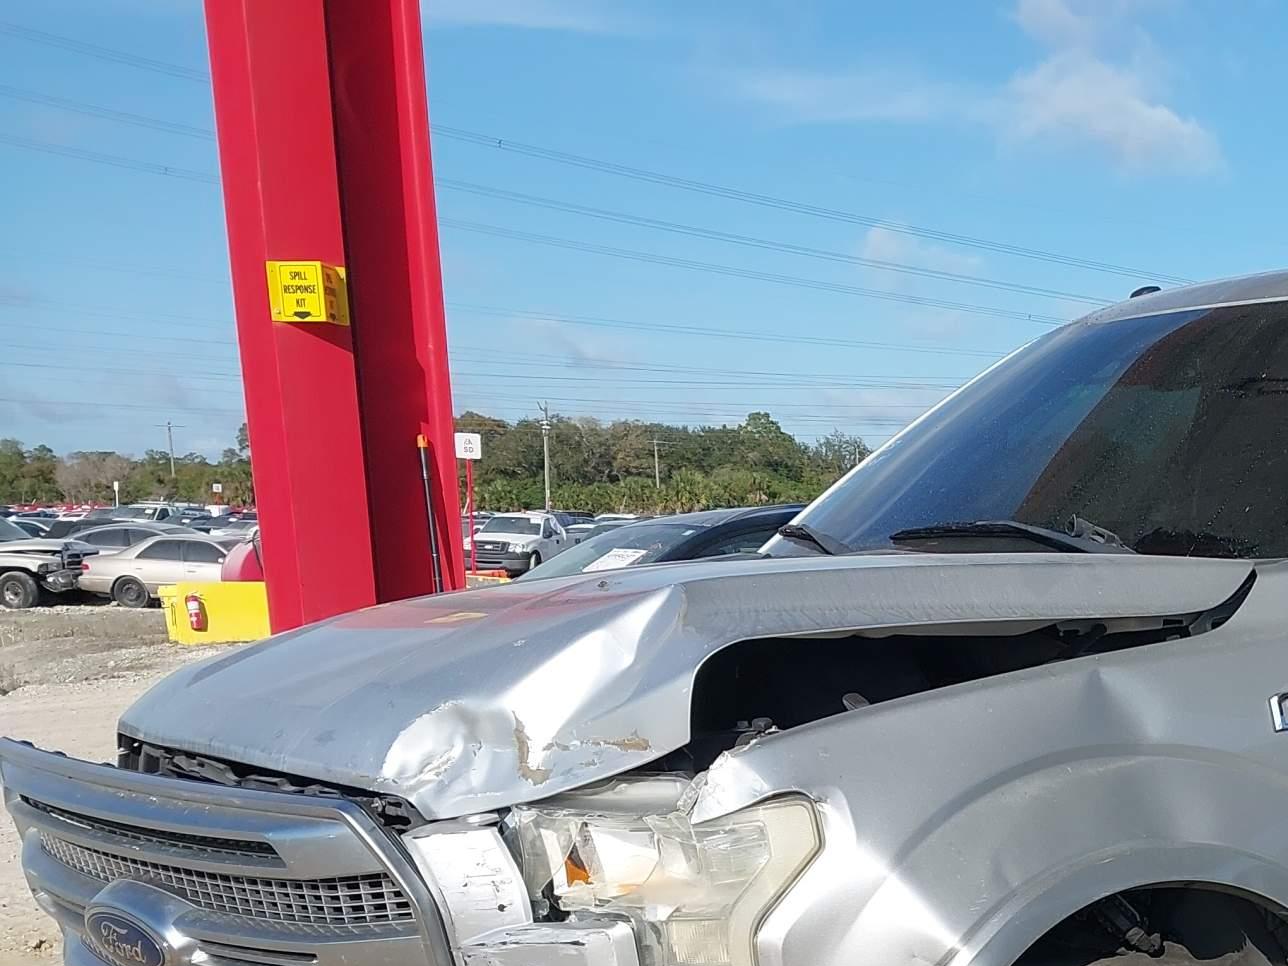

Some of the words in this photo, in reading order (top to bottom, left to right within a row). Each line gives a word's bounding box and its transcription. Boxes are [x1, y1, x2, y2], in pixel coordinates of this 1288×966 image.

[289, 271, 308, 281] SPILL
[283, 284, 317, 294] RESPONSE
[295, 297, 307, 308] KIT
[100, 921, 147, 964] Ford
